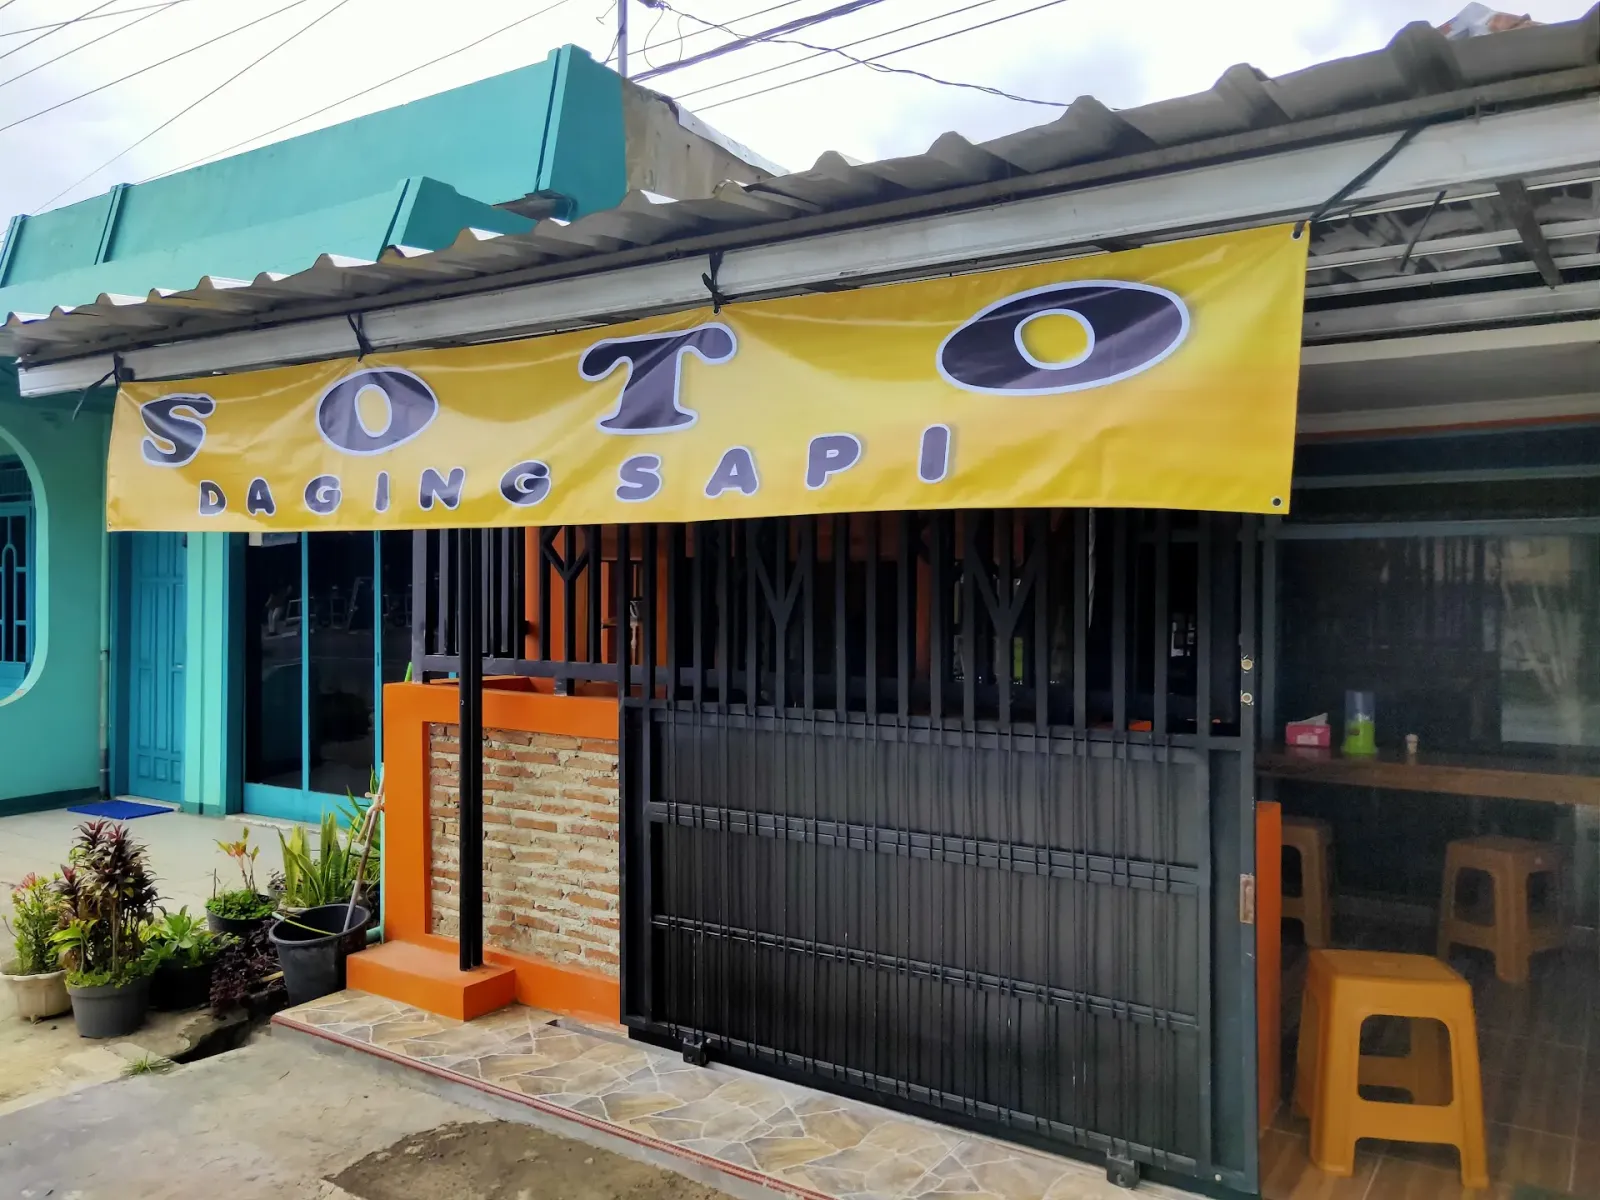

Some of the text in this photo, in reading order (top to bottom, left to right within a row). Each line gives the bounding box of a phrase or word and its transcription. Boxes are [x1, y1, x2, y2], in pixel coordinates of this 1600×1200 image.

[140, 279, 1190, 467] SOTO
[199, 424, 952, 516] DAGING SAPI
